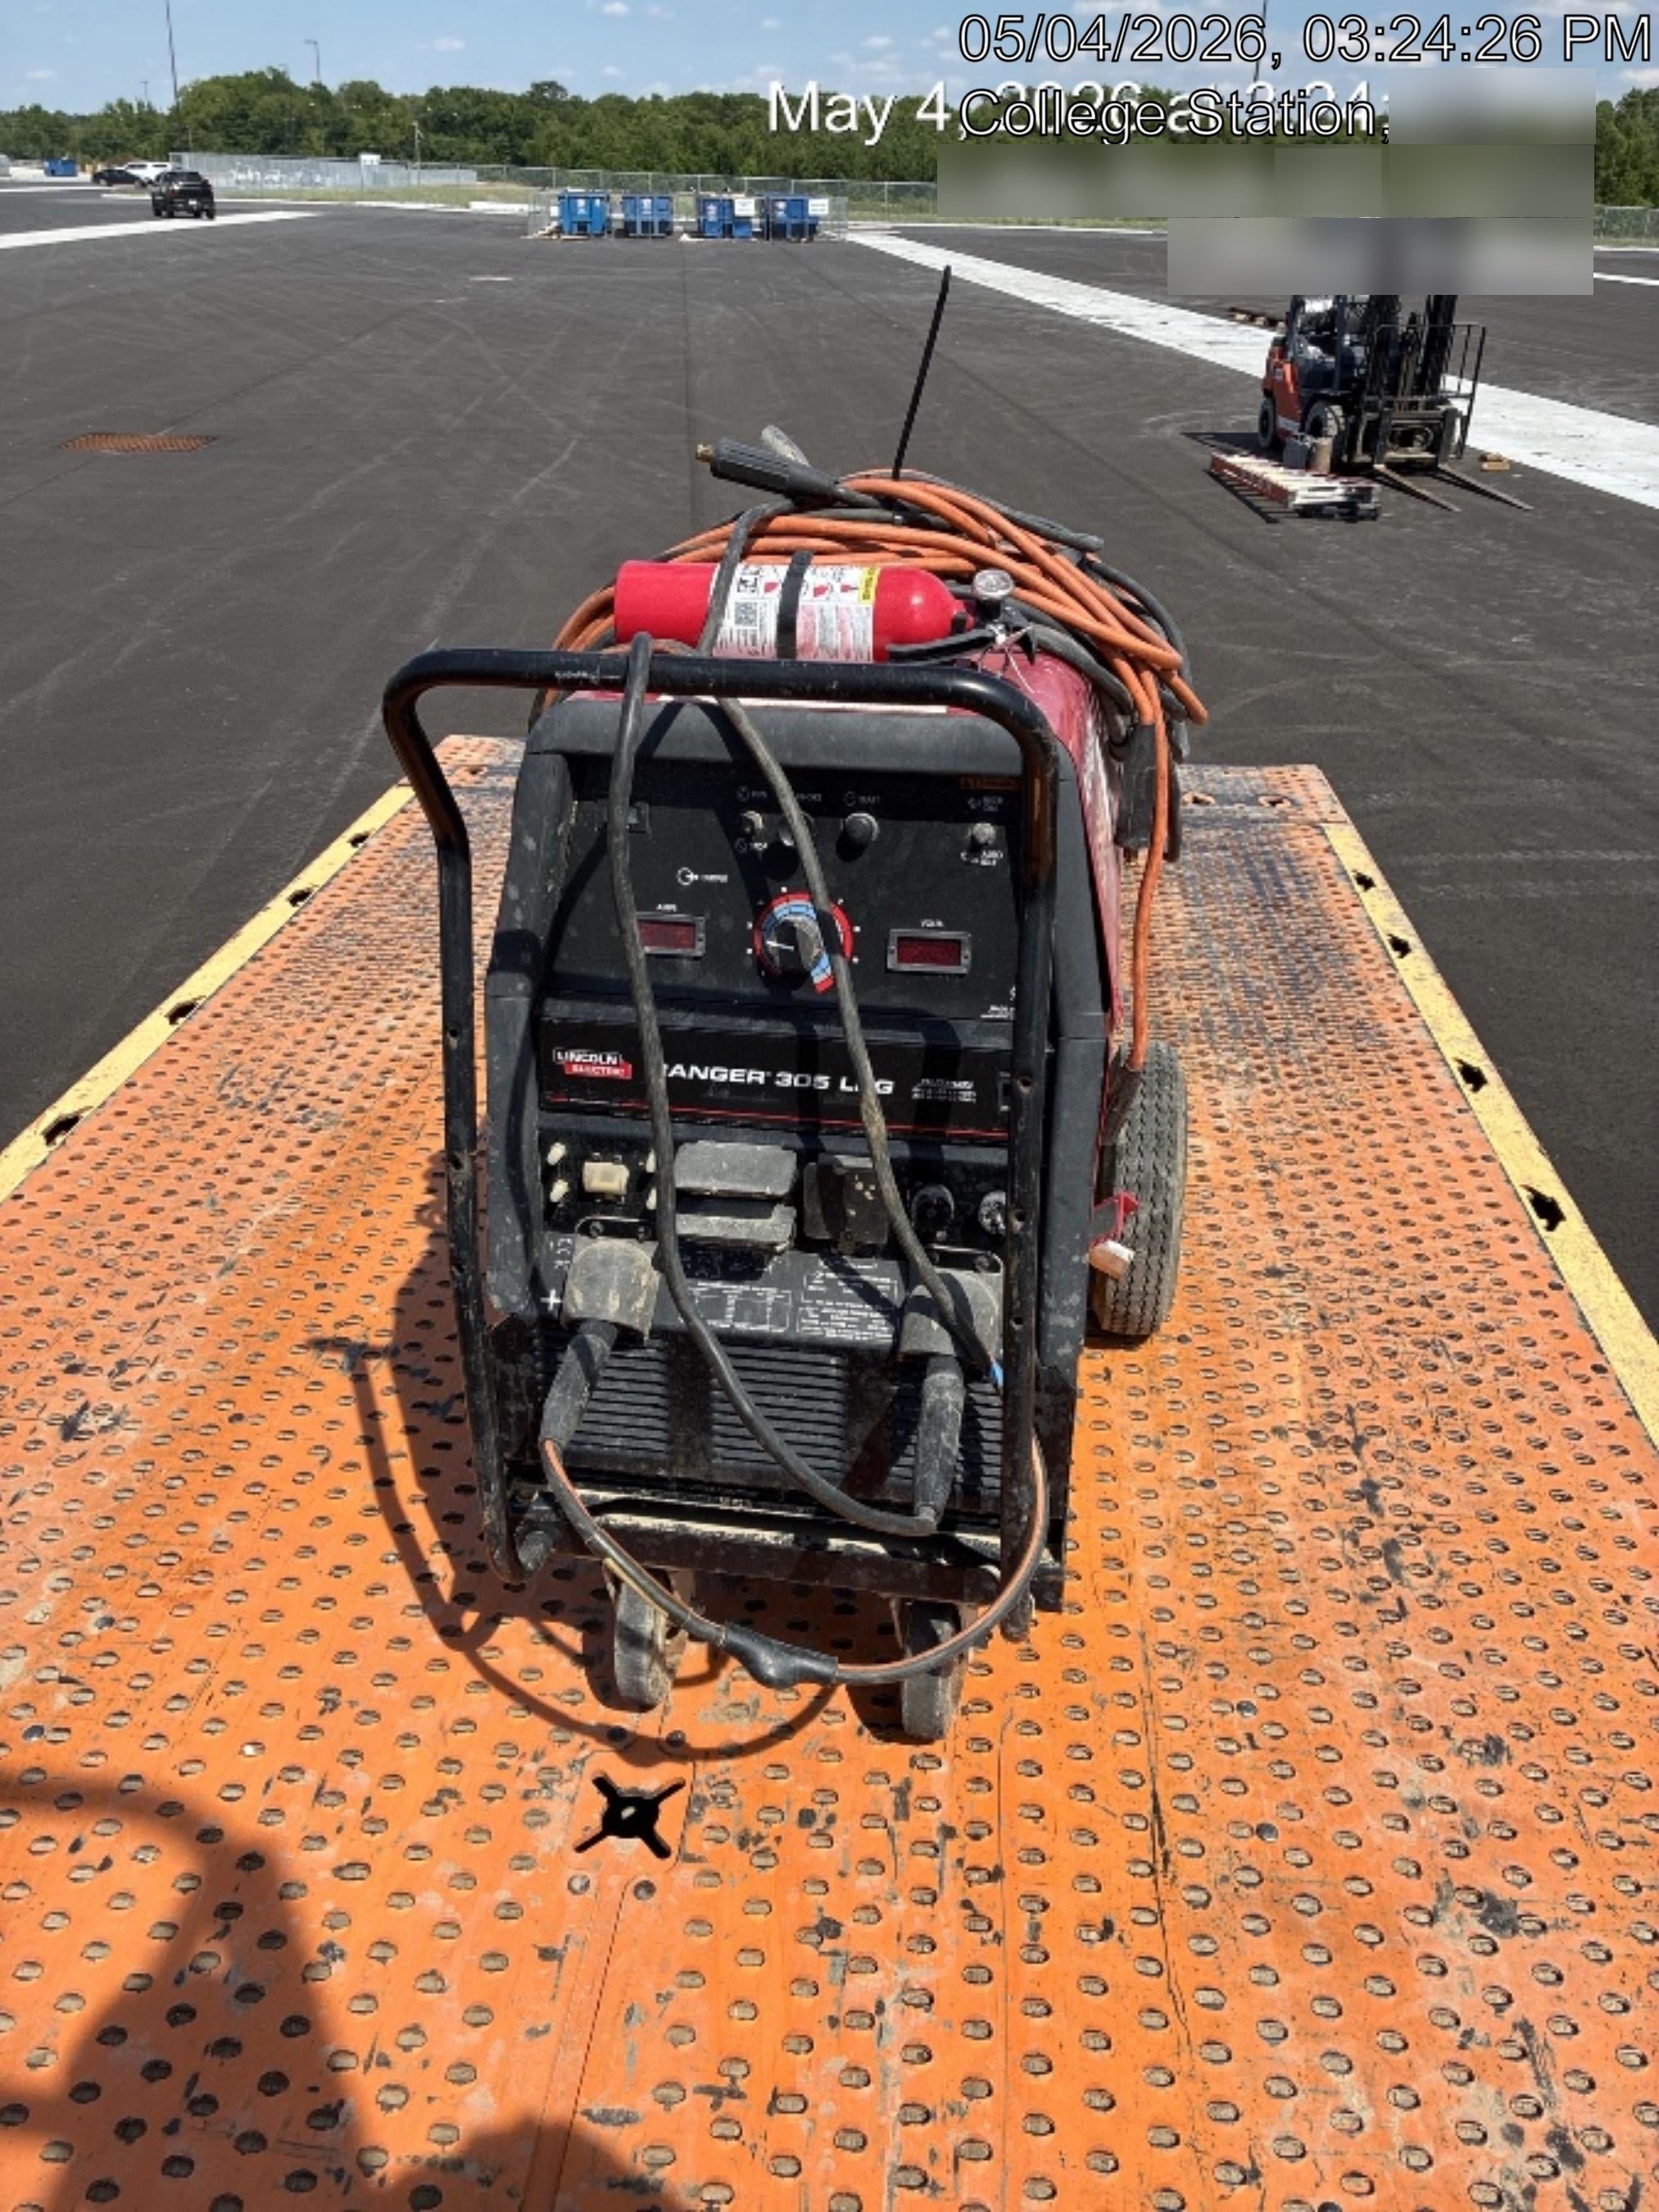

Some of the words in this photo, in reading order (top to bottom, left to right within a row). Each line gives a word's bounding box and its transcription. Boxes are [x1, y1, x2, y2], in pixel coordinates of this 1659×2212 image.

[556, 1051, 618, 1065] LINCOLN
[663, 1063, 765, 1086] ANGER
[774, 1071, 831, 1090] 305
[839, 1077, 895, 1095] LG
